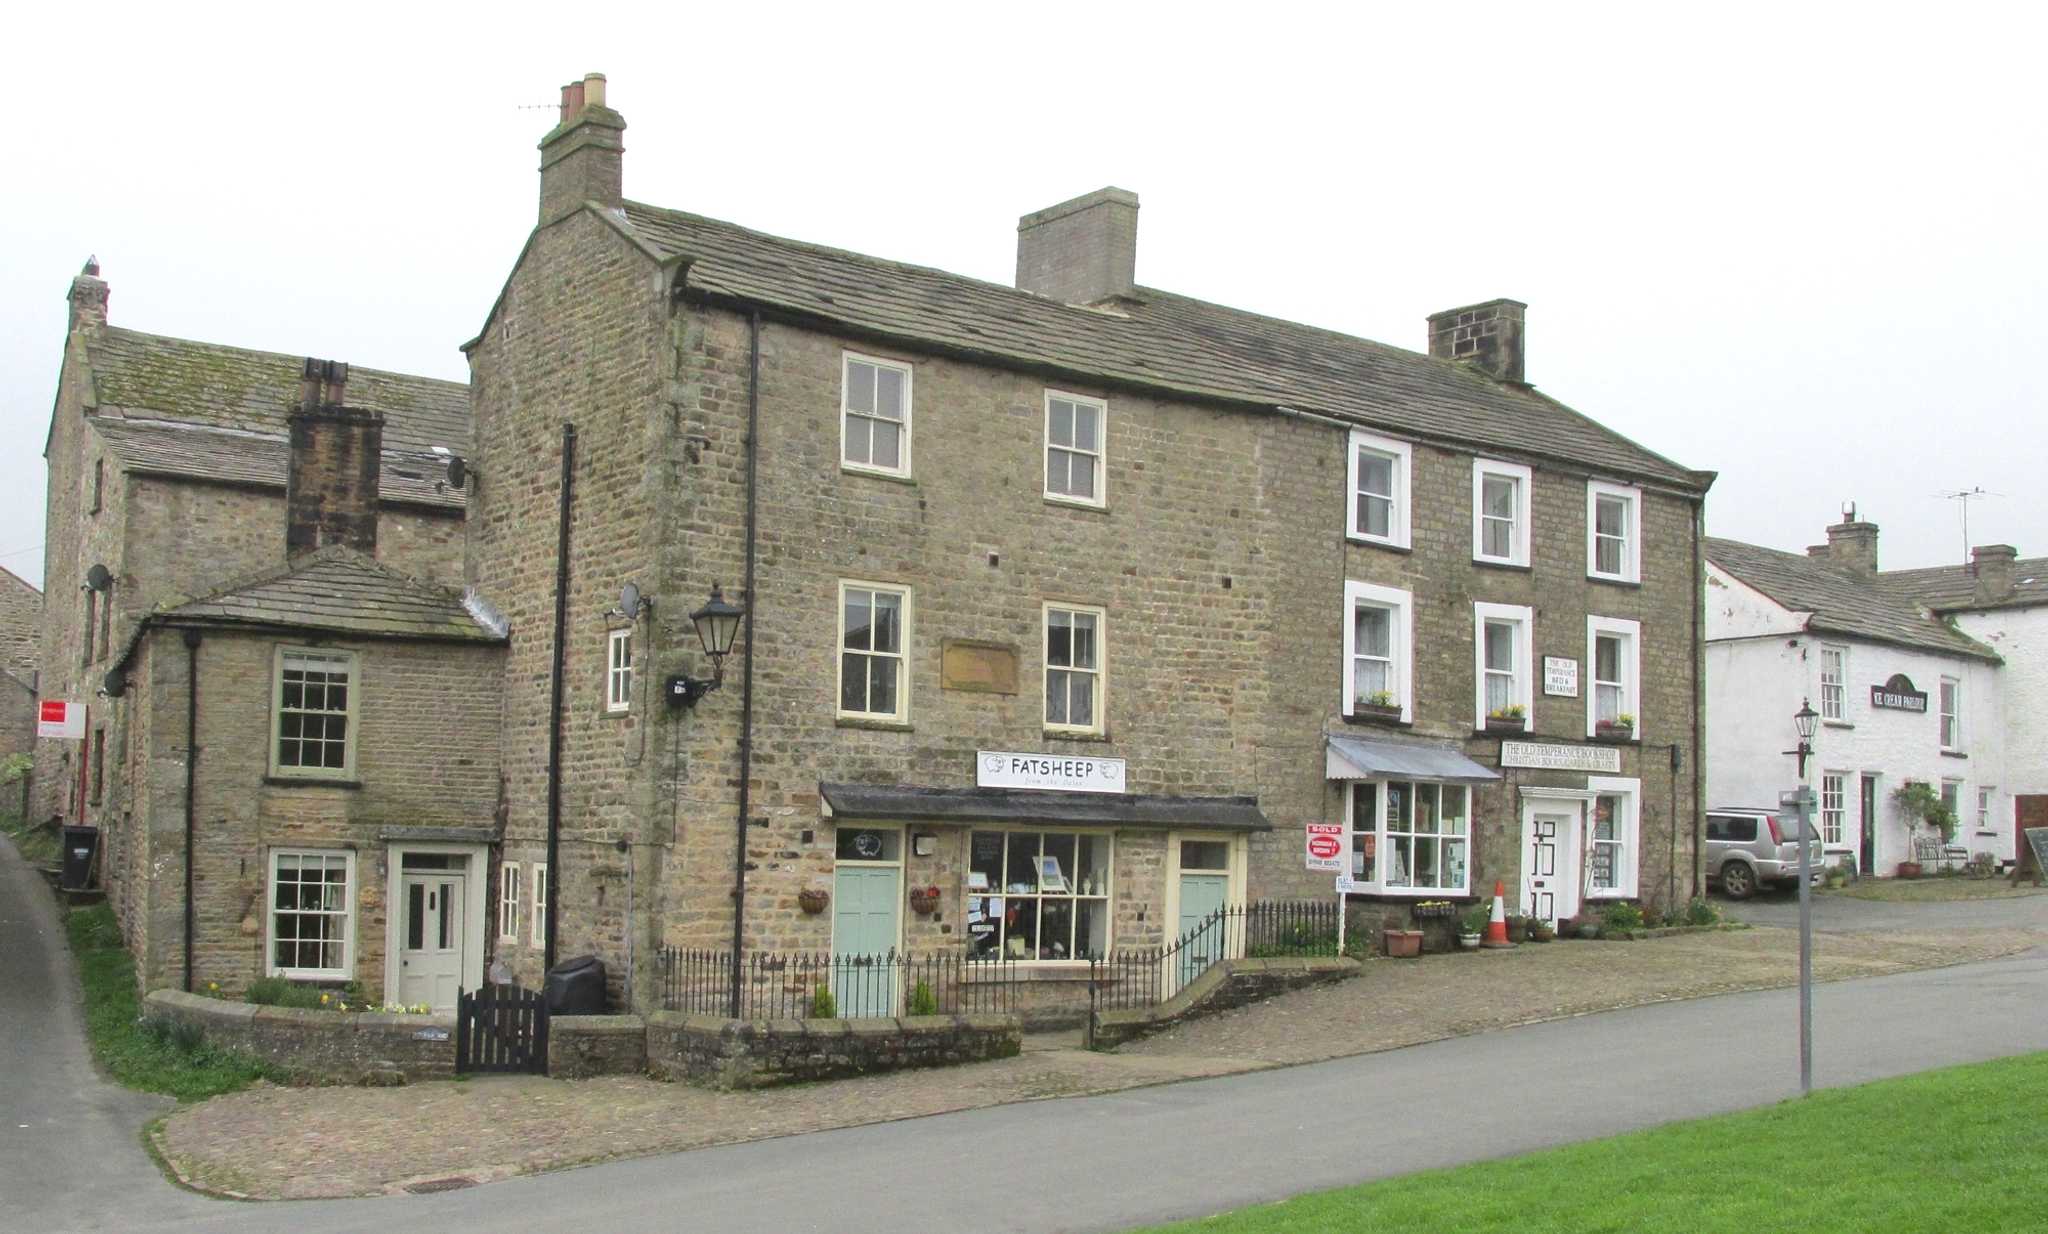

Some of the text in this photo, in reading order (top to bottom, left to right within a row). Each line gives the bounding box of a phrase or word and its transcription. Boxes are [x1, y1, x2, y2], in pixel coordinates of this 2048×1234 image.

[1884, 694, 1902, 707] CREAM
[1506, 743, 1519, 755] THE
[1520, 744, 1535, 756] OLD
[1536, 745, 1579, 758] TEMPERANCE
[1011, 758, 1094, 778] FATSHEEP
[1312, 825, 1338, 833] SOLD
